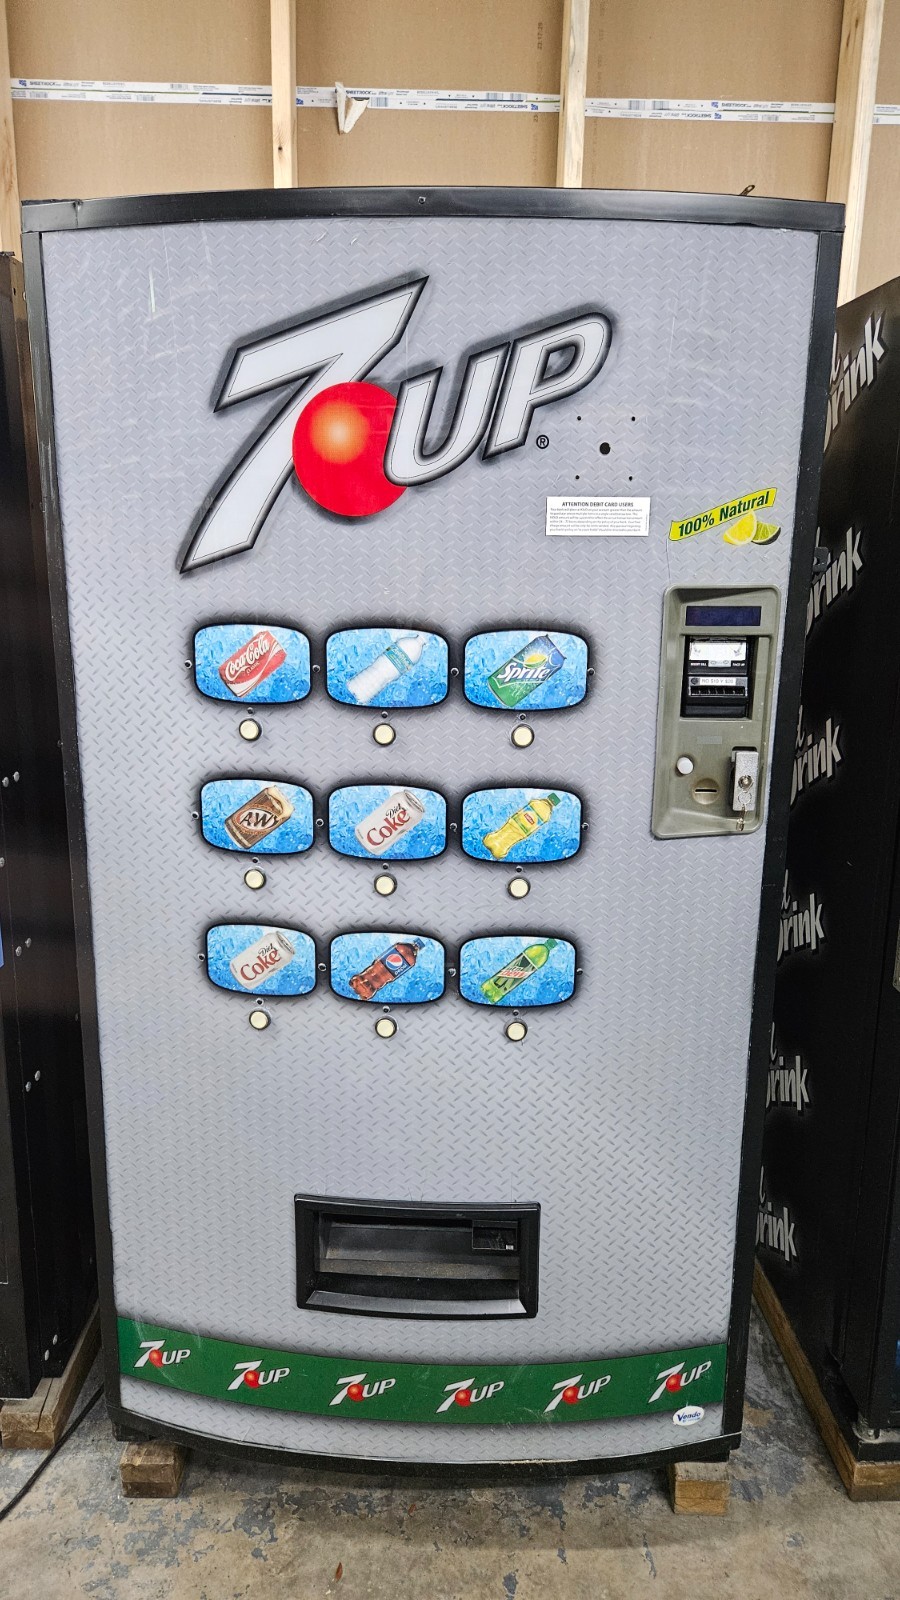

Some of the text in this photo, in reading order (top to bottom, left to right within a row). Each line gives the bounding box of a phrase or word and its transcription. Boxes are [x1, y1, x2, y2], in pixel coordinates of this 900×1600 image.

[678, 491, 770, 536] 100% Natural
[225, 633, 270, 681] Coca-Cola
[497, 662, 551, 682] Sprite
[386, 803, 405, 818] Diet
[366, 810, 411, 846] Coke
[258, 943, 278, 956] Diet
[240, 949, 282, 981] Coke
[677, 1411, 701, 1421] Vendo
